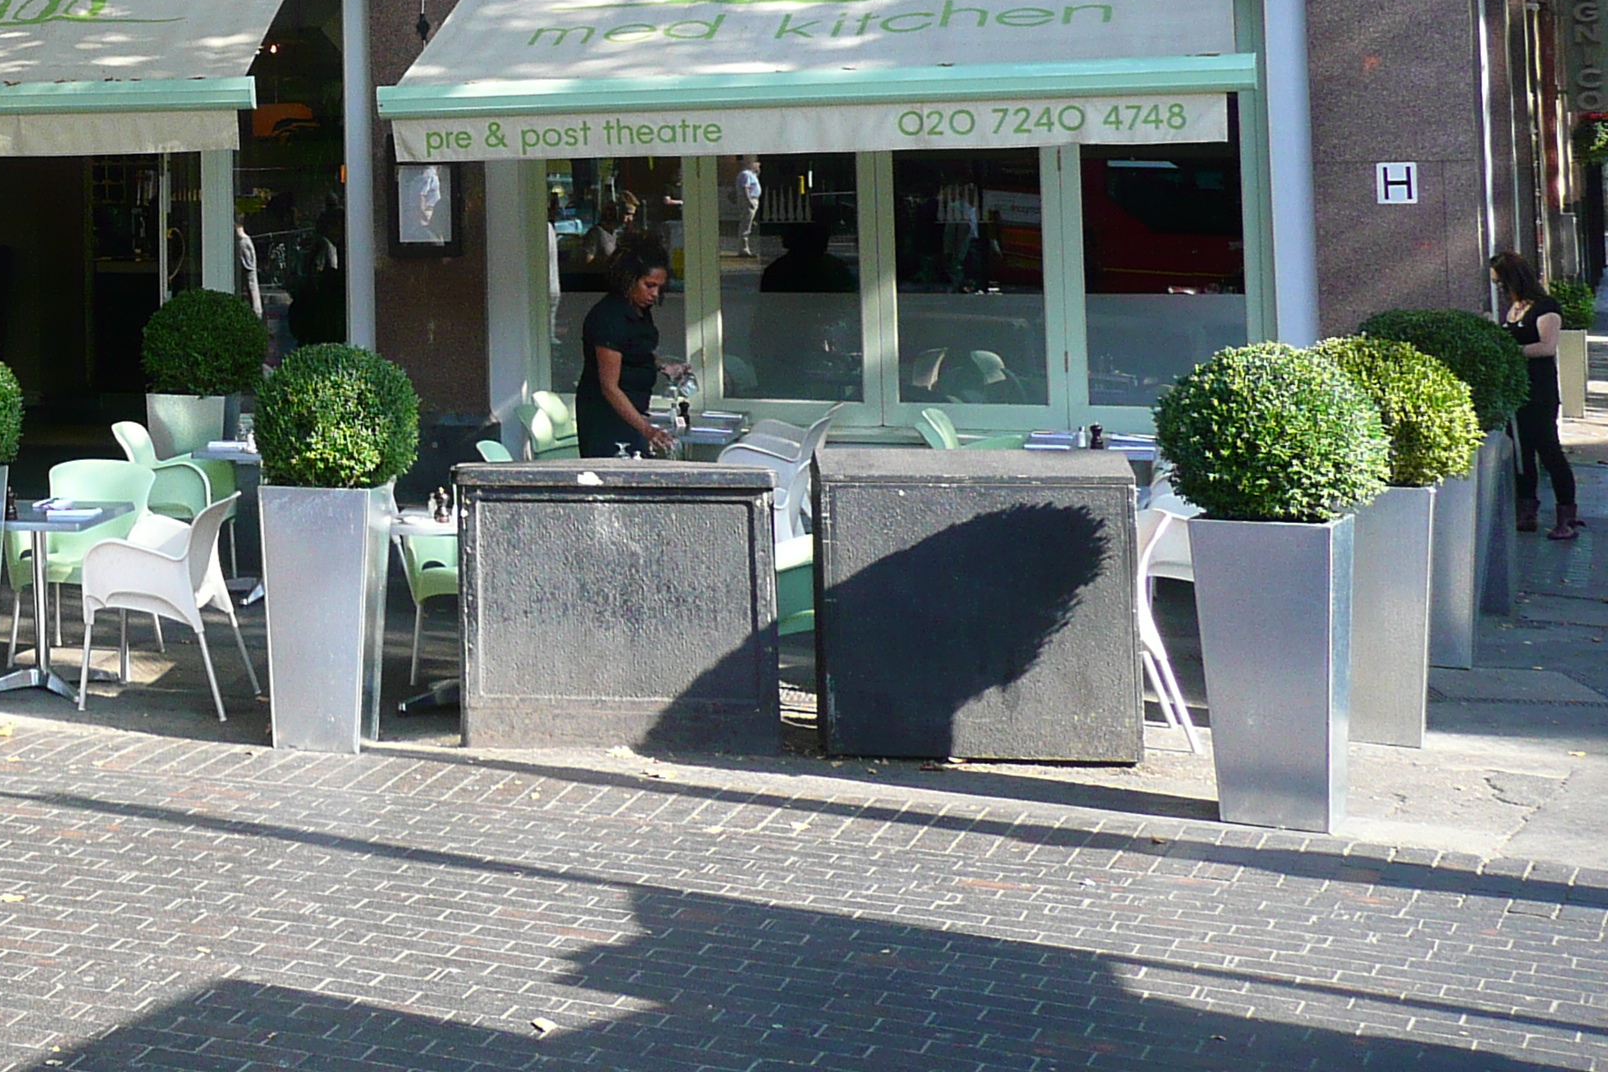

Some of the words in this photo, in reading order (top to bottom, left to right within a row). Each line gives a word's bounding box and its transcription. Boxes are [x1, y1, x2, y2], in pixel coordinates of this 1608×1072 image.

[528, 14, 727, 46] med
[774, 0, 1113, 39] kitchen
[425, 129, 472, 158] pre
[484, 122, 508, 148] &
[520, 120, 591, 155] post
[602, 118, 722, 146] theatre
[897, 110, 975, 136] 020
[992, 105, 1085, 135] 7240
[1103, 103, 1187, 131] 4748
[1382, 166, 1413, 200] H
